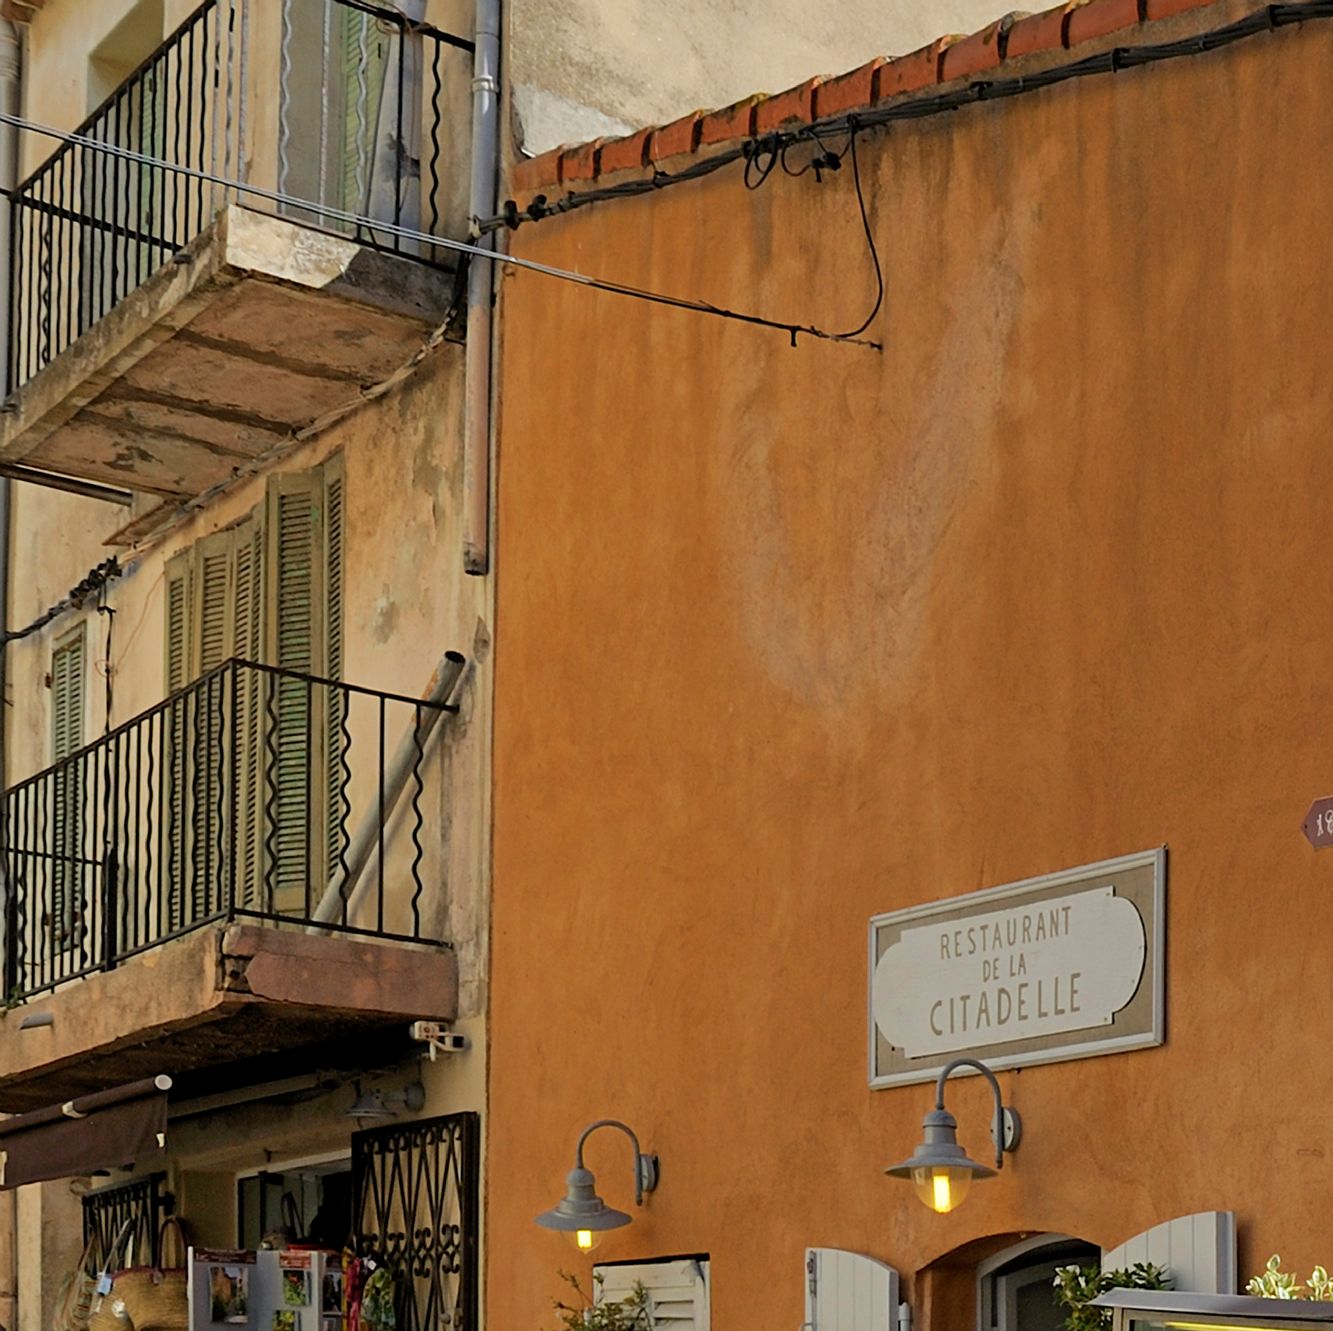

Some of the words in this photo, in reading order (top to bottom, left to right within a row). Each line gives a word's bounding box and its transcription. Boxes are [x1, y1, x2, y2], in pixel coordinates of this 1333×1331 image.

[940, 905, 1072, 961] RESTAURANT
[982, 957, 1000, 983] DE
[1009, 952, 1027, 978] LA
[929, 972, 1082, 1037] CITADELLE
